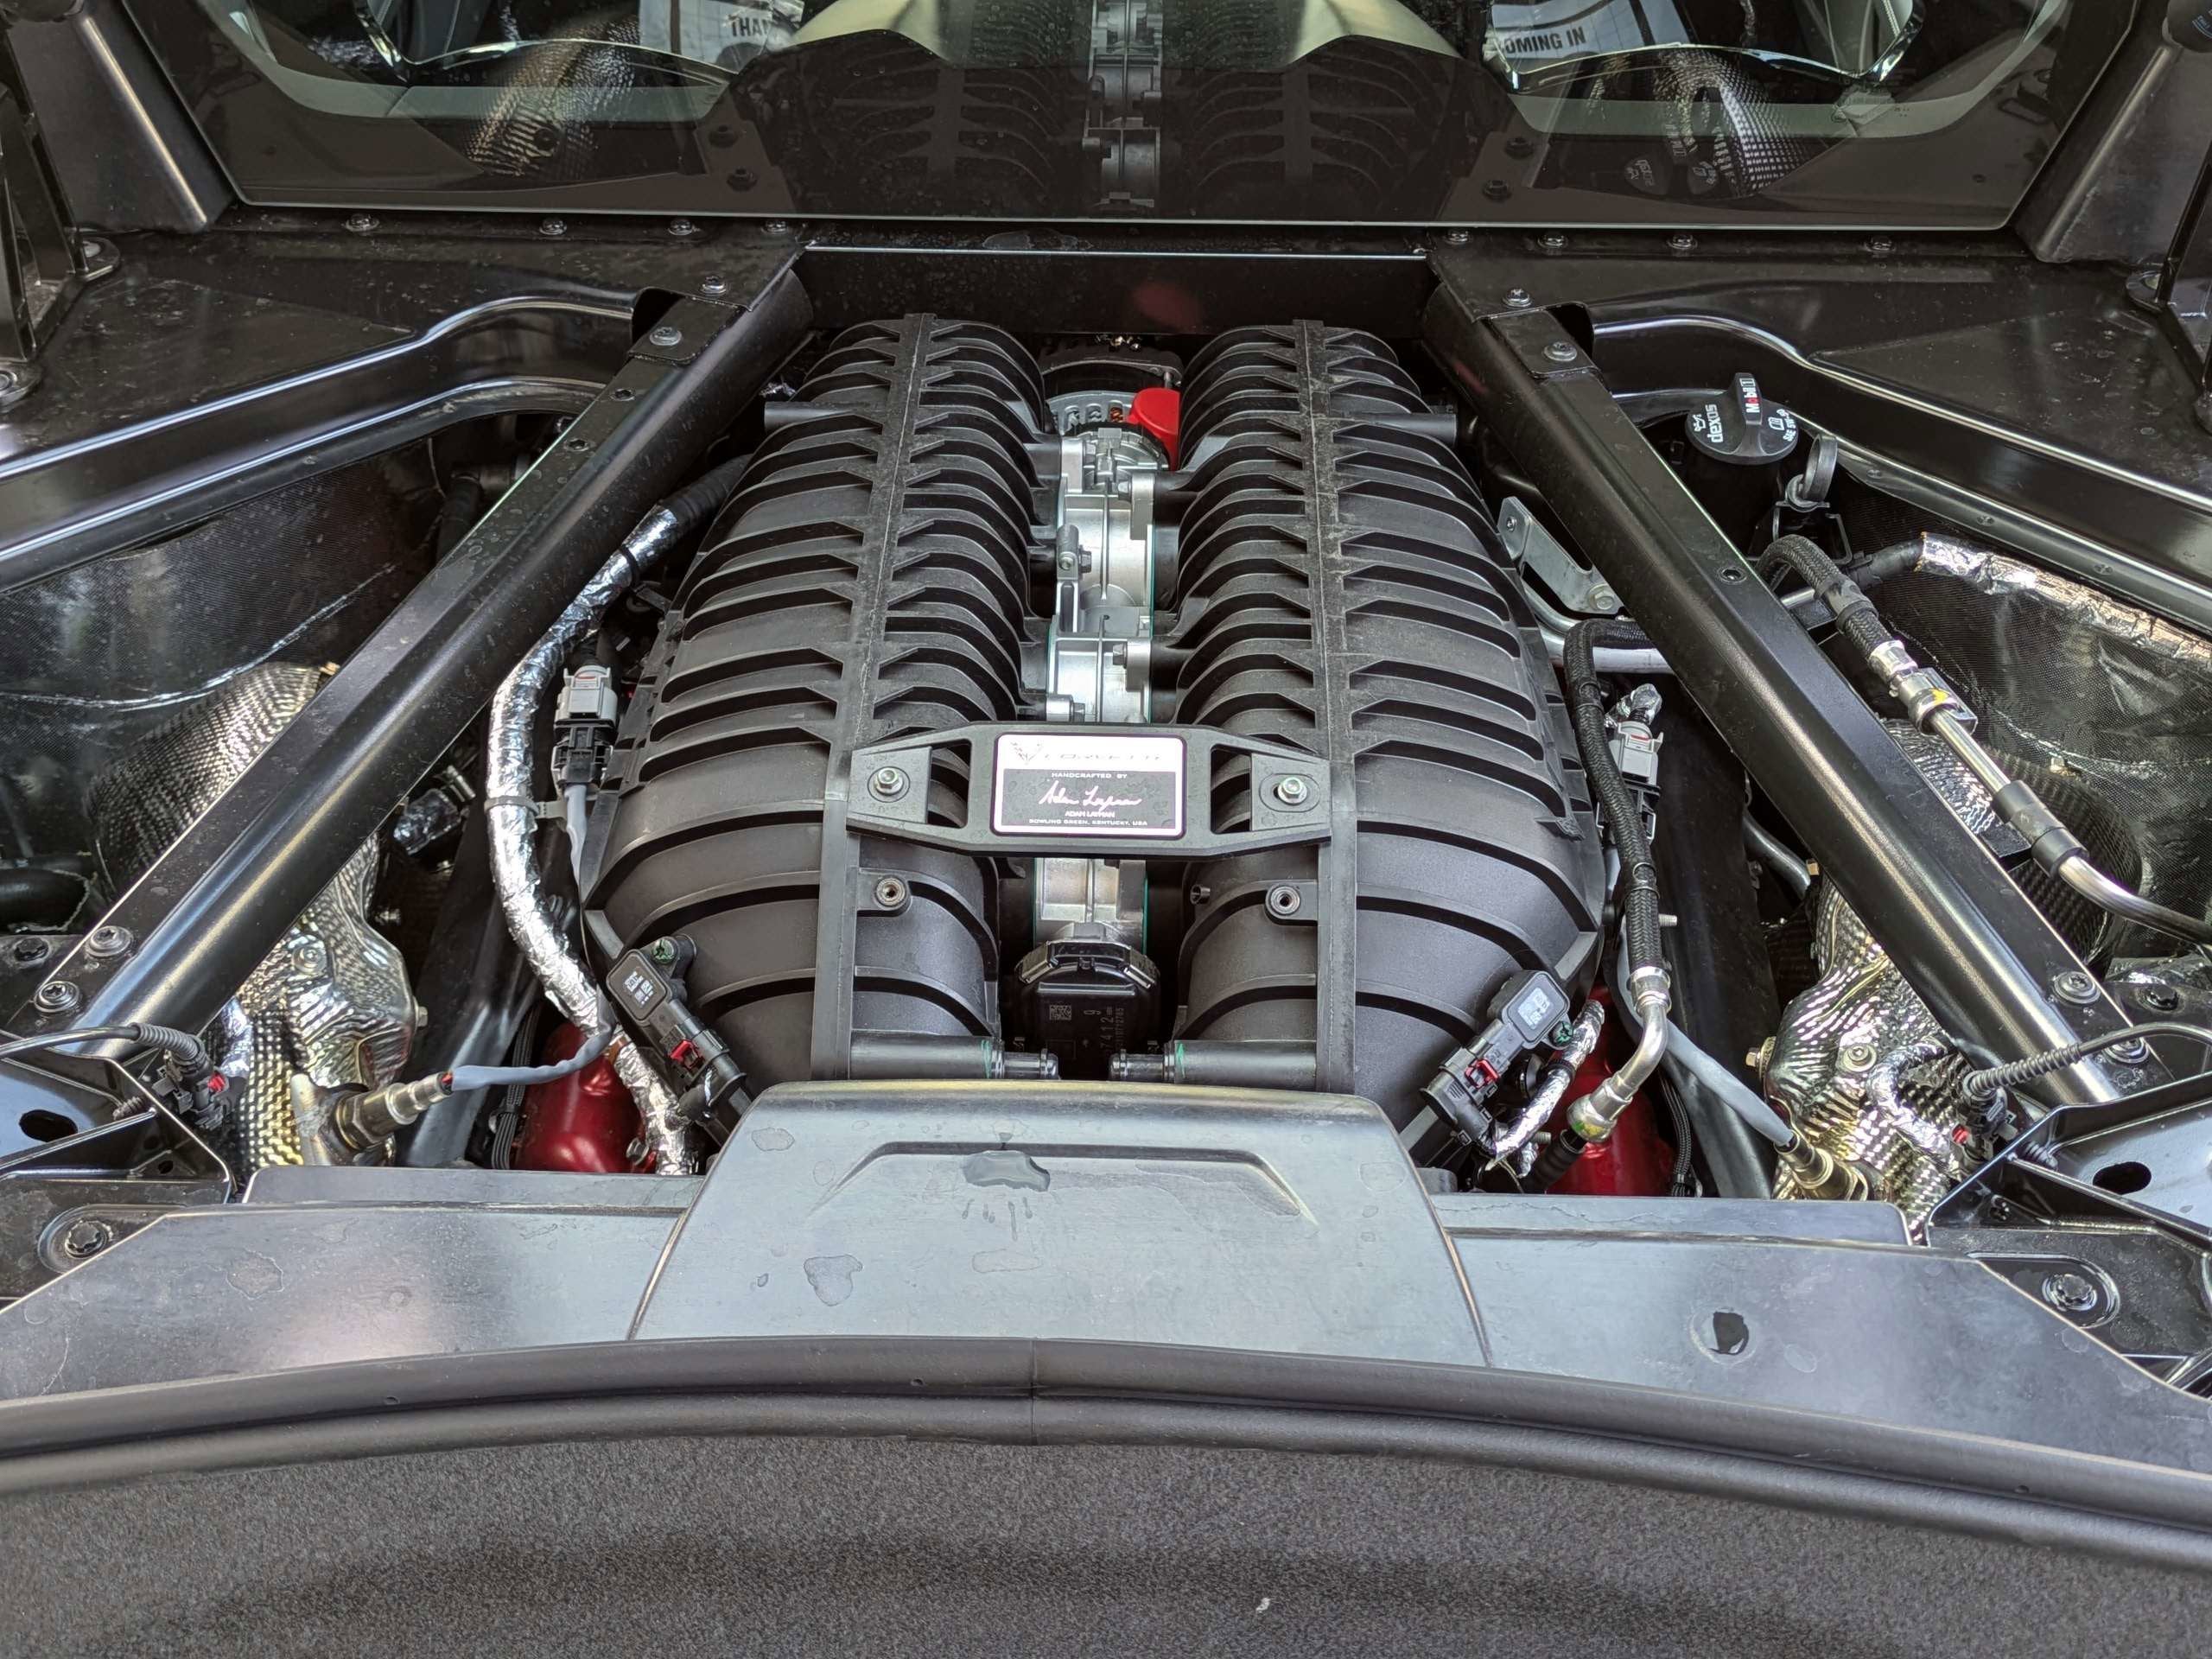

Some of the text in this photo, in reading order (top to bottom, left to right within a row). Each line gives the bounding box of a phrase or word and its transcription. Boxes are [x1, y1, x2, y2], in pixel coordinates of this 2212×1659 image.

[1503, 26, 1586, 54] OMING IN
[1742, 387, 1760, 413] Mobil
[1705, 404, 1724, 442] dexos
